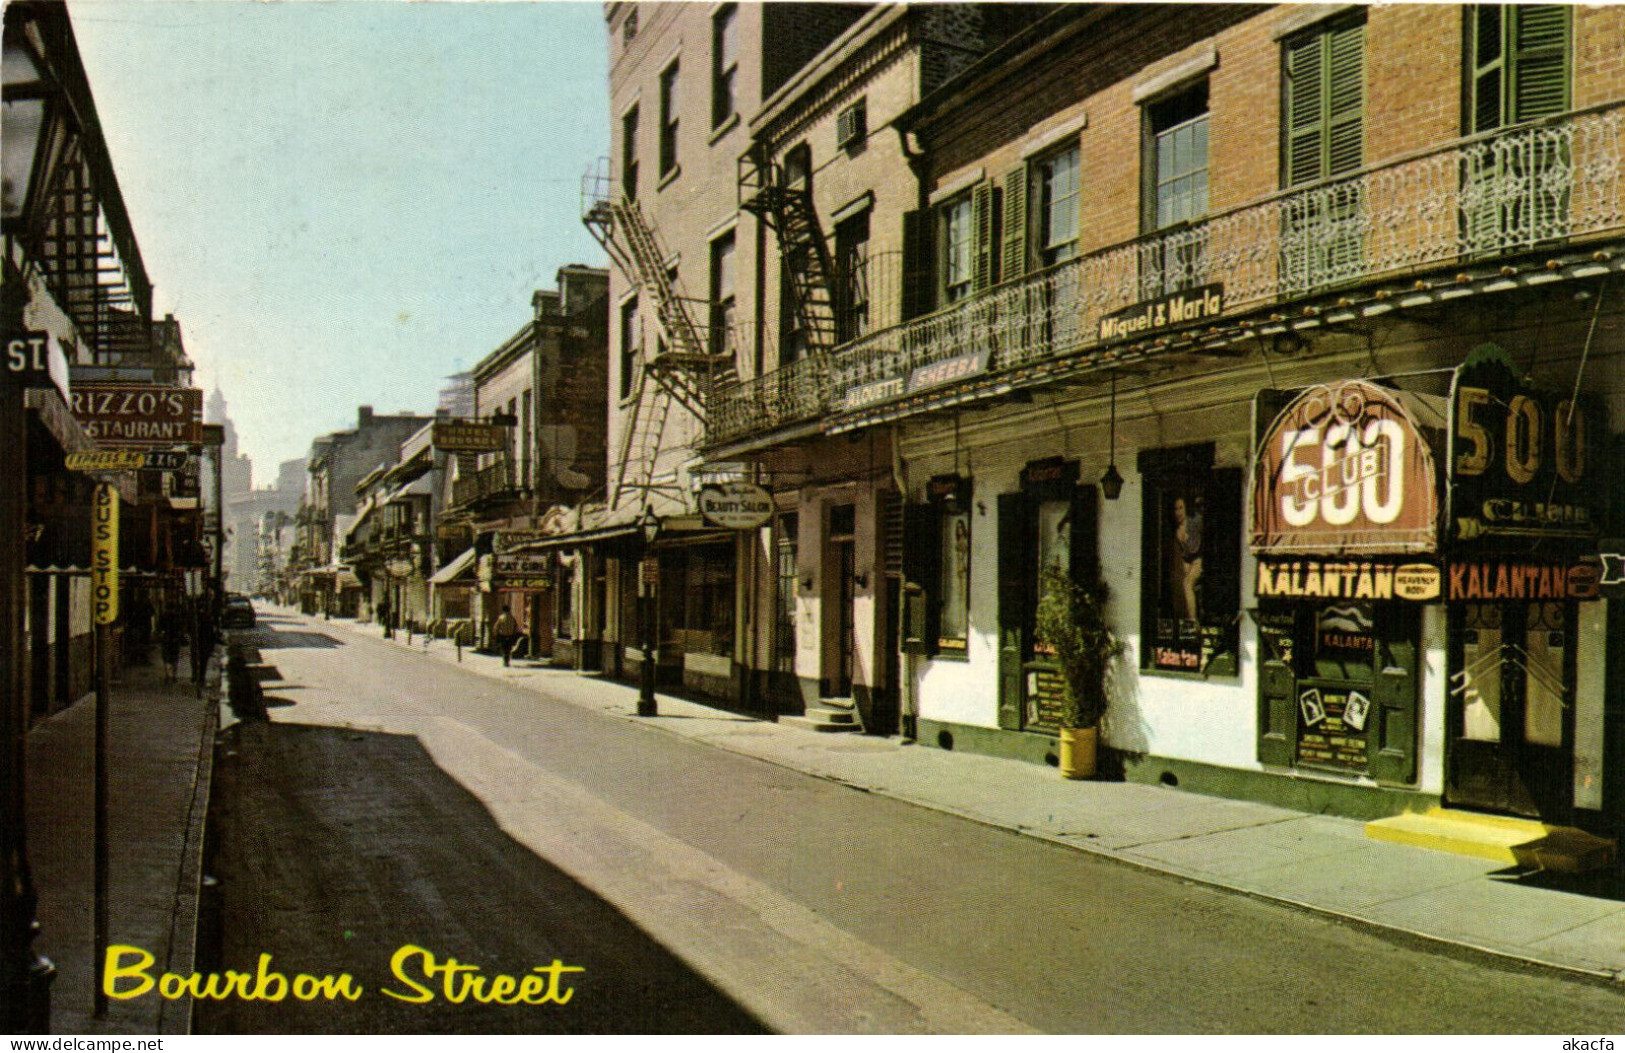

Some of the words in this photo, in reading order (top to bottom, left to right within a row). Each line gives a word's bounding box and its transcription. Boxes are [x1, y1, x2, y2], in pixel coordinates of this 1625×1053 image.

[1154, 303, 1166, 327] &
[1169, 289, 1220, 323] Marla
[8, 339, 45, 371] ST
[80, 420, 186, 438] STAURANT
[1457, 386, 1584, 484] 500
[1282, 418, 1404, 526] 500
[1305, 452, 1378, 499] CLUB
[706, 500, 739, 512] BEAUTY
[1257, 562, 1394, 599] KALANTAN
[1450, 563, 1566, 599] KALANTAN
[1324, 634, 1373, 650] KALANTA
